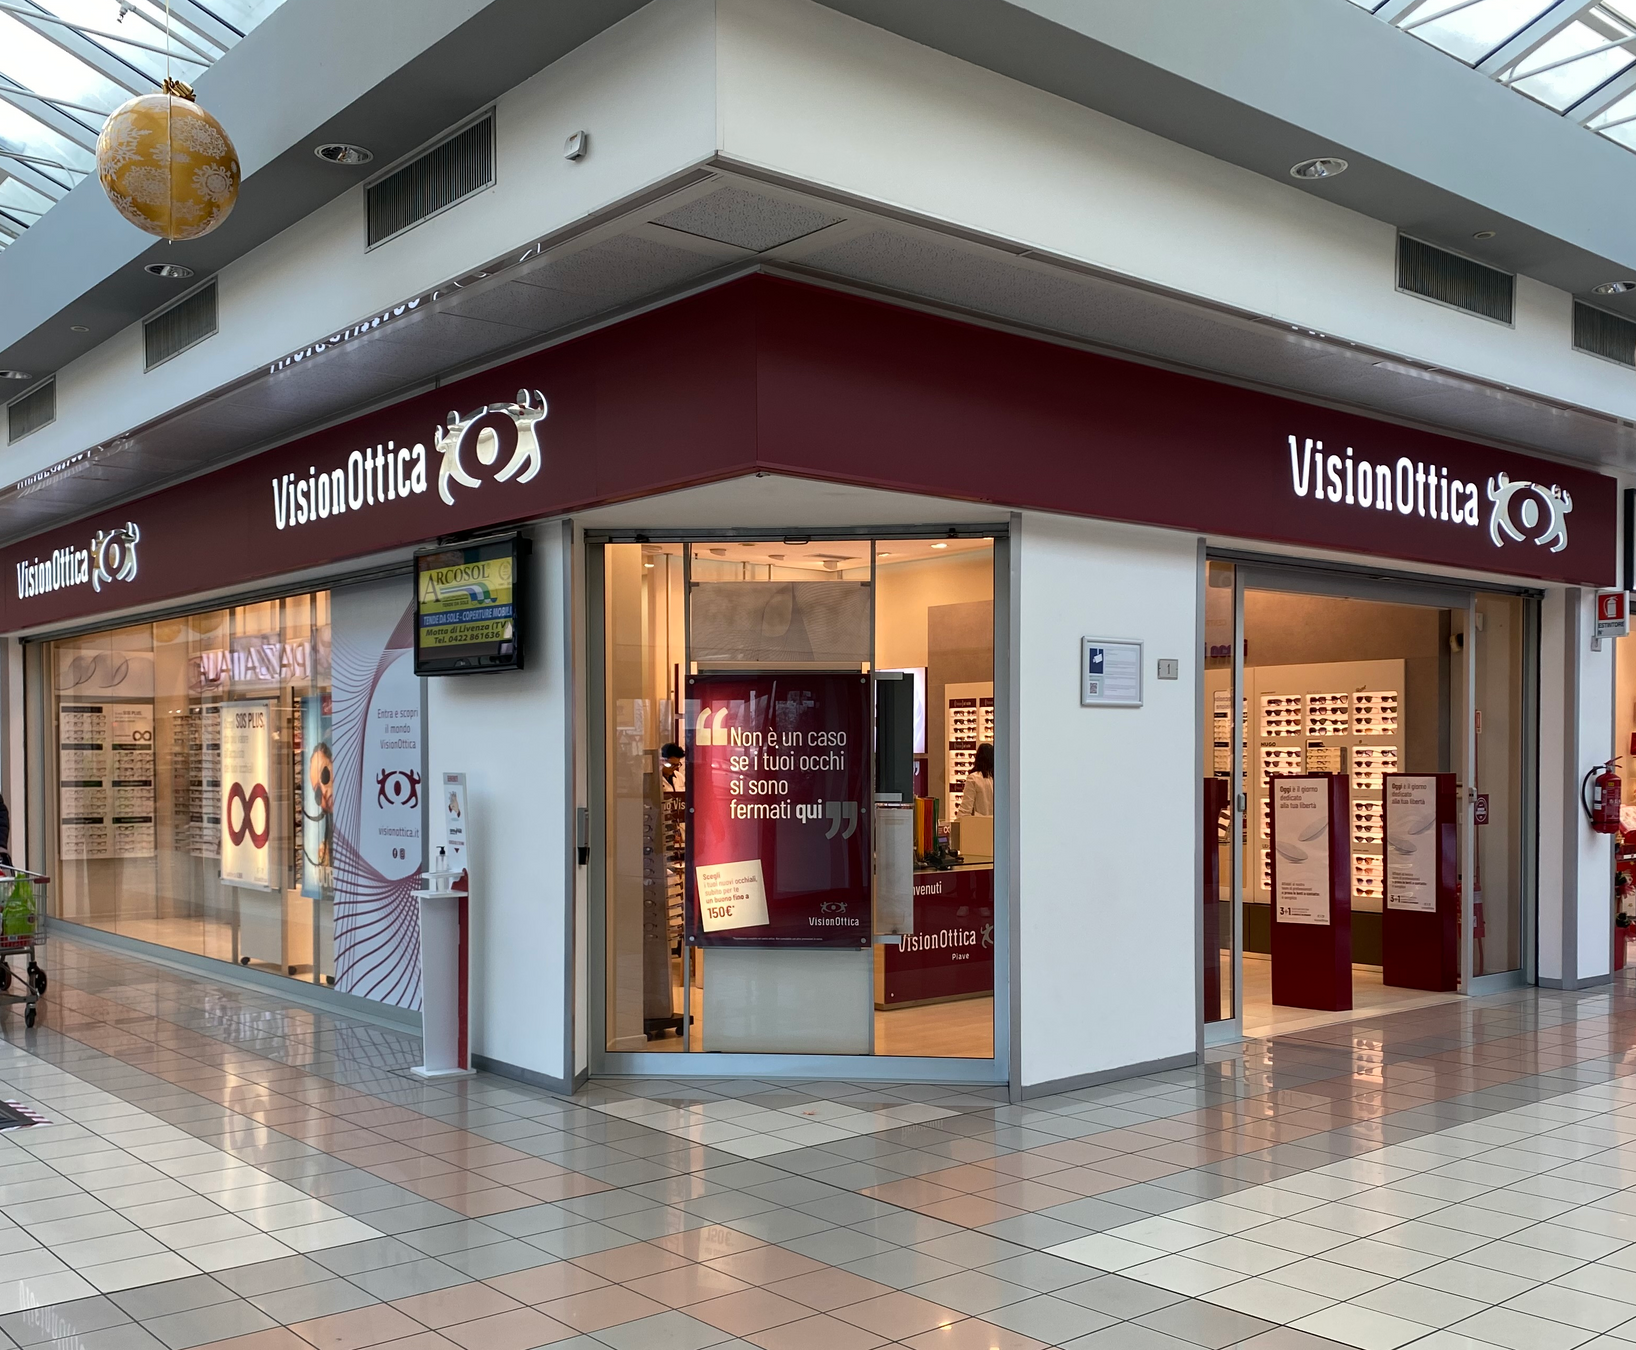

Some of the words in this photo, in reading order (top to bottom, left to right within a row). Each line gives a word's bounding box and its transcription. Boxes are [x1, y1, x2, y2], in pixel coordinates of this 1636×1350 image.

[272, 441, 427, 531] VisionOttica
[1288, 435, 1479, 526] VisionOttica
[16, 548, 89, 600] VisionOttica
[424, 614, 438, 625] TENDE
[439, 614, 446, 623] DA
[446, 612, 460, 622] SOLE
[462, 608, 492, 620] COPERTURE
[426, 628, 448, 636] Motta
[450, 626, 458, 634] di
[460, 622, 490, 632] Livenza
[491, 620, 510, 631] (TV)
[434, 636, 446, 644] Tel.
[448, 634, 468, 642] 0422
[470, 631, 500, 640] 861636
[236, 712, 247, 729] SOS
[378, 708, 394, 719] Entra
[394, 710, 398, 718] e
[400, 707, 418, 720] scopri
[390, 723, 411, 734] mondo
[730, 727, 762, 746] Non
[767, 727, 777, 746] è
[782, 732, 802, 746] un
[808, 732, 846, 746] caso
[380, 738, 416, 750] VisionOttica
[730, 755, 748, 771] se
[754, 751, 758, 770] i
[763, 751, 794, 771] tuoi
[800, 751, 844, 770] occhi
[730, 775, 744, 794] si
[748, 780, 788, 795] sono
[1280, 786, 1292, 794] Oggi
[1301, 786, 1318, 794] giorno
[730, 799, 791, 819] fermati
[796, 799, 822, 824] qui
[378, 826, 420, 838] visionottica.it
[703, 872, 720, 880] Scegli
[1280, 907, 1291, 915] 3+1
[808, 916, 860, 926] VisionOttica
